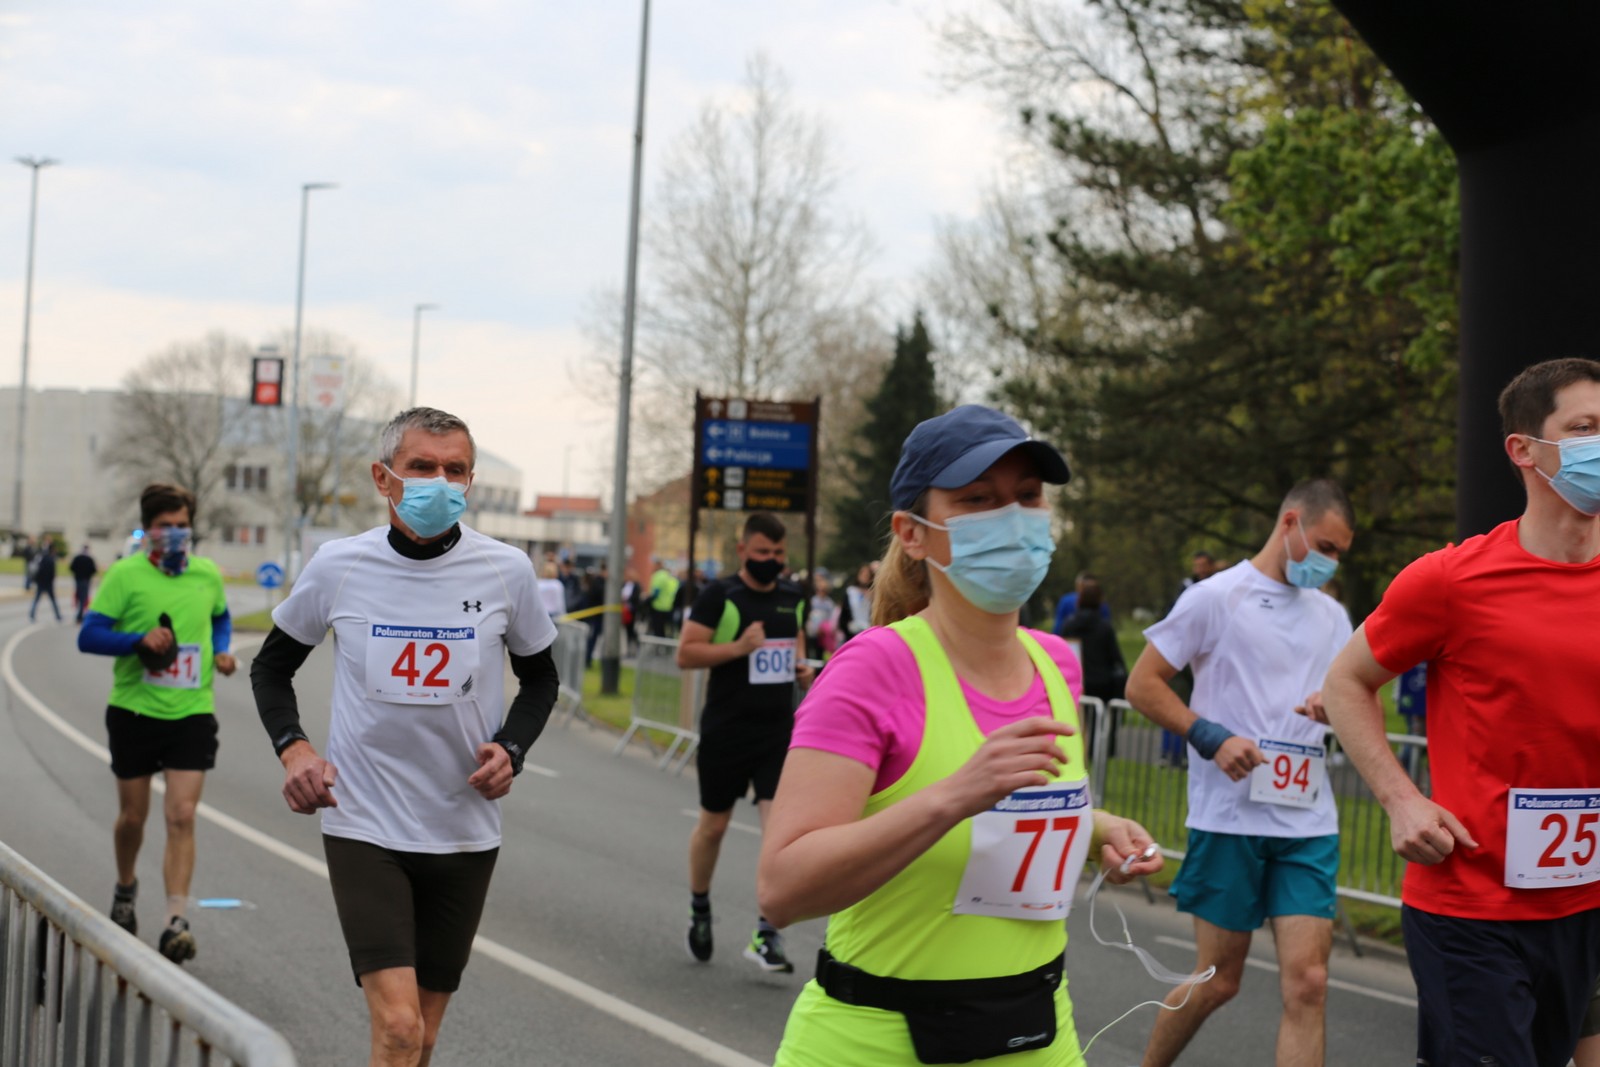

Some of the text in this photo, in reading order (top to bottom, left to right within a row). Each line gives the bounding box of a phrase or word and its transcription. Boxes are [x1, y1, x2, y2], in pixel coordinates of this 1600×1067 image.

[375, 626, 434, 638] Polumaraton
[391, 641, 450, 687] 42
[1273, 754, 1310, 792] 94
[995, 794, 1065, 811] olumaraton
[1518, 797, 1586, 808] Polumaraton
[1010, 816, 1080, 892] 77
[1537, 812, 1600, 868] 25
